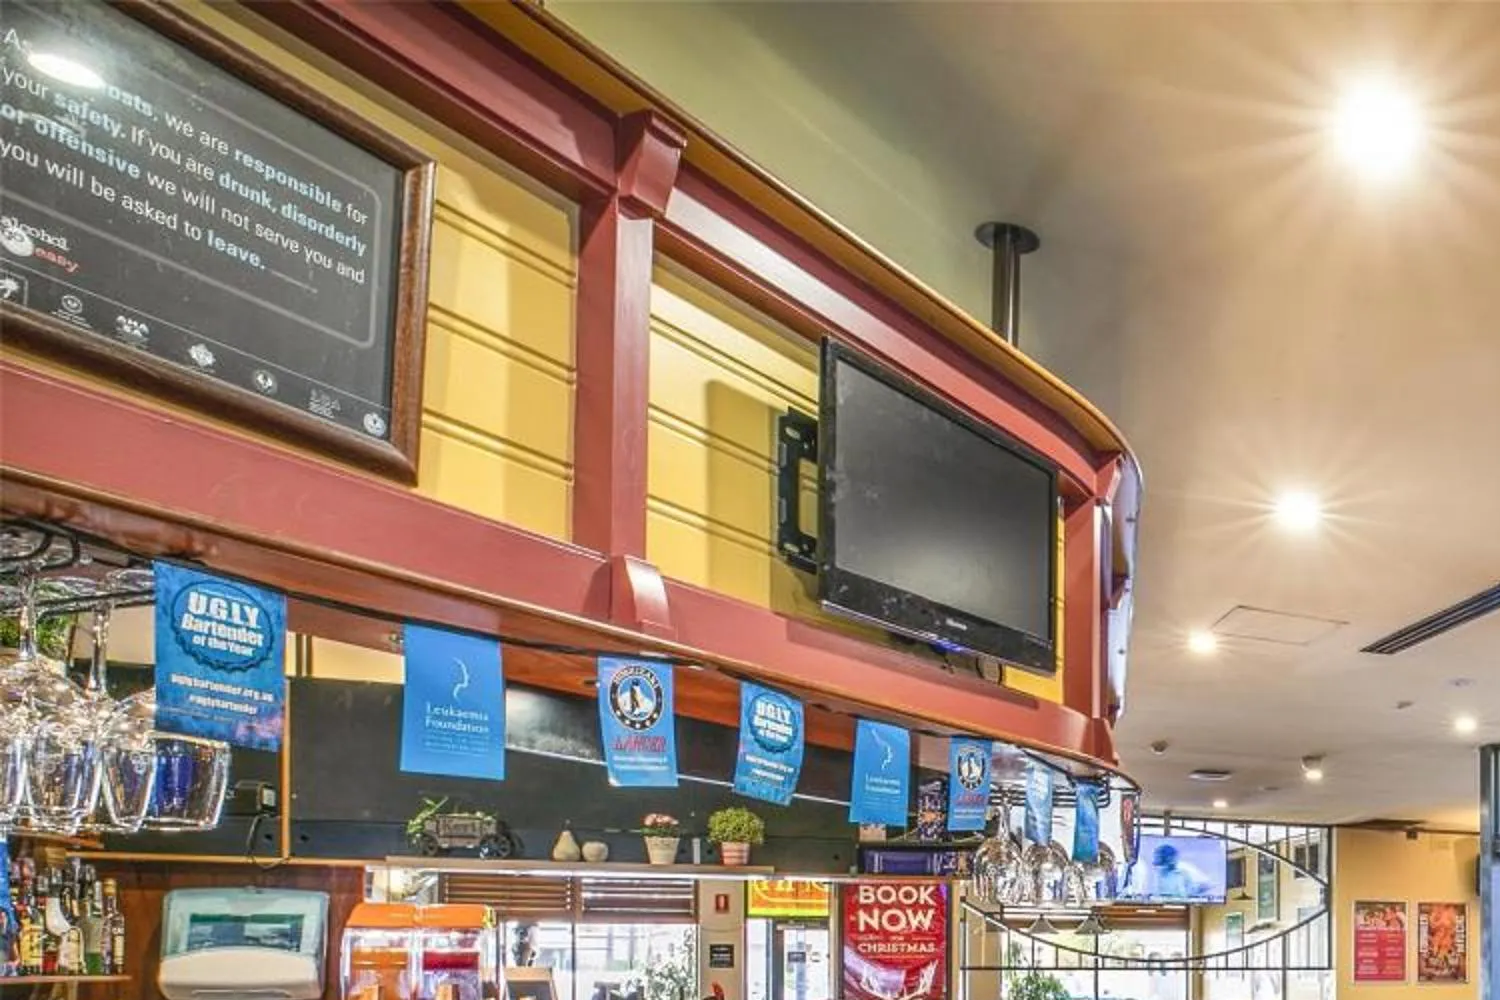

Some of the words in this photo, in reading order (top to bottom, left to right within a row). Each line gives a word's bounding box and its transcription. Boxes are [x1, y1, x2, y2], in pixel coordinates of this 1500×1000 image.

[2, 66, 50, 99] your
[54, 92, 127, 139] safety.
[130, 125, 147, 147] If
[149, 138, 181, 166] you
[185, 157, 215, 181] are
[218, 172, 277, 214] drunk,
[281, 203, 368, 257] disorderly
[165, 111, 195, 138] we
[199, 130, 230, 156] are
[234, 148, 342, 213] responsible
[345, 203, 368, 226] for
[0, 103, 27, 125] or
[33, 117, 141, 179] offensive
[147, 170, 177, 196] we
[182, 186, 216, 215] will
[220, 206, 250, 232] not
[254, 222, 300, 254] serve
[303, 244, 333, 270] you
[336, 261, 366, 285] and
[0, 137, 39, 168] you
[45, 158, 84, 189] will
[90, 175, 116, 202] be
[121, 193, 178, 231] asked
[182, 219, 202, 242] to
[206, 229, 267, 271] leave.
[181, 613, 264, 648] Bartender
[192, 633, 206, 648] of
[425, 701, 490, 722] Leukaemia
[425, 715, 490, 734] Foundation
[858, 885, 937, 906] BOOK
[857, 908, 936, 933] NOW
[857, 941, 936, 955] CHRISTMAS
